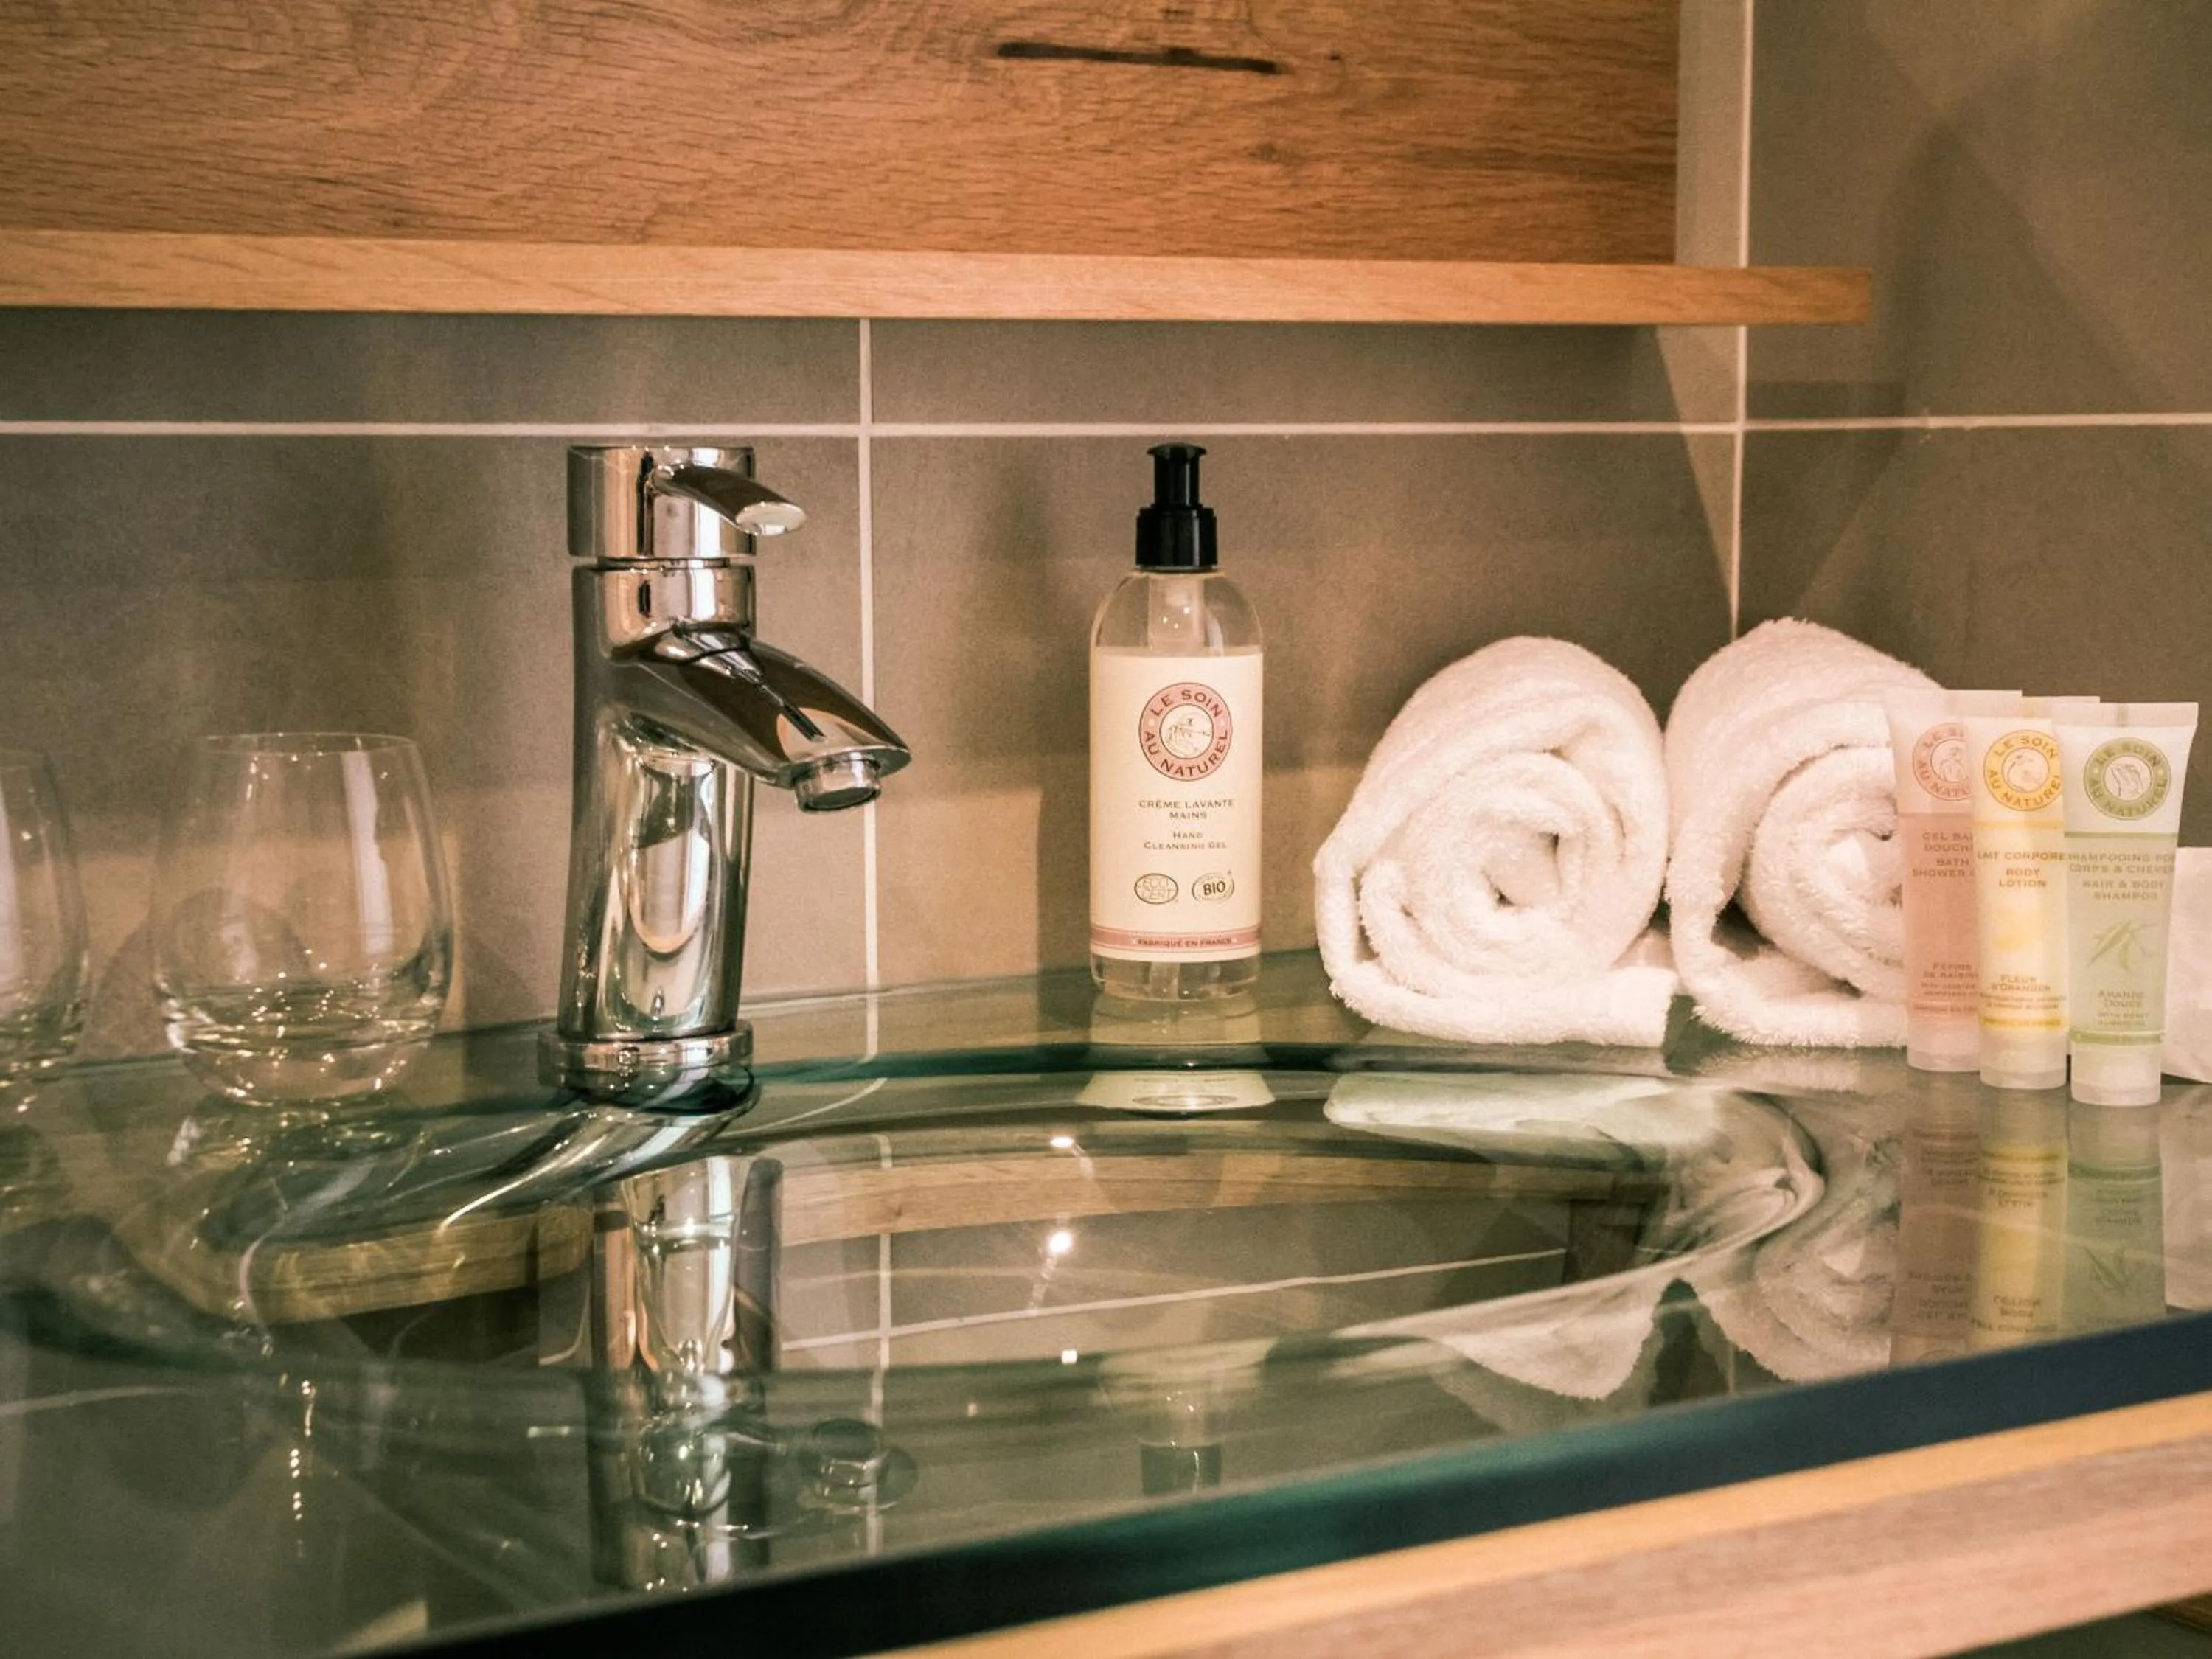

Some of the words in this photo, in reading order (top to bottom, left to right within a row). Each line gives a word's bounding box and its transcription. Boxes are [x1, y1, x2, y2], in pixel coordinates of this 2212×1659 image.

[1151, 695, 1175, 717] LE
[1181, 689, 1222, 717] SOIN
[1144, 731, 1160, 756] AU
[1160, 729, 1228, 776] NATUREL
[1994, 739, 2014, 757] LE
[2020, 736, 2059, 759] SOIN
[1988, 769, 2001, 789] AU
[1185, 799, 1234, 809] LAVANTE
[1169, 812, 1208, 820] MAINS
[1173, 831, 1204, 839] HAND
[1921, 832, 1947, 841] GEL
[2004, 851, 2066, 860] CORPORE
[2006, 867, 2040, 877] BODY
[1203, 881, 1226, 895] BIO
[1999, 878, 2048, 888] LOTION
